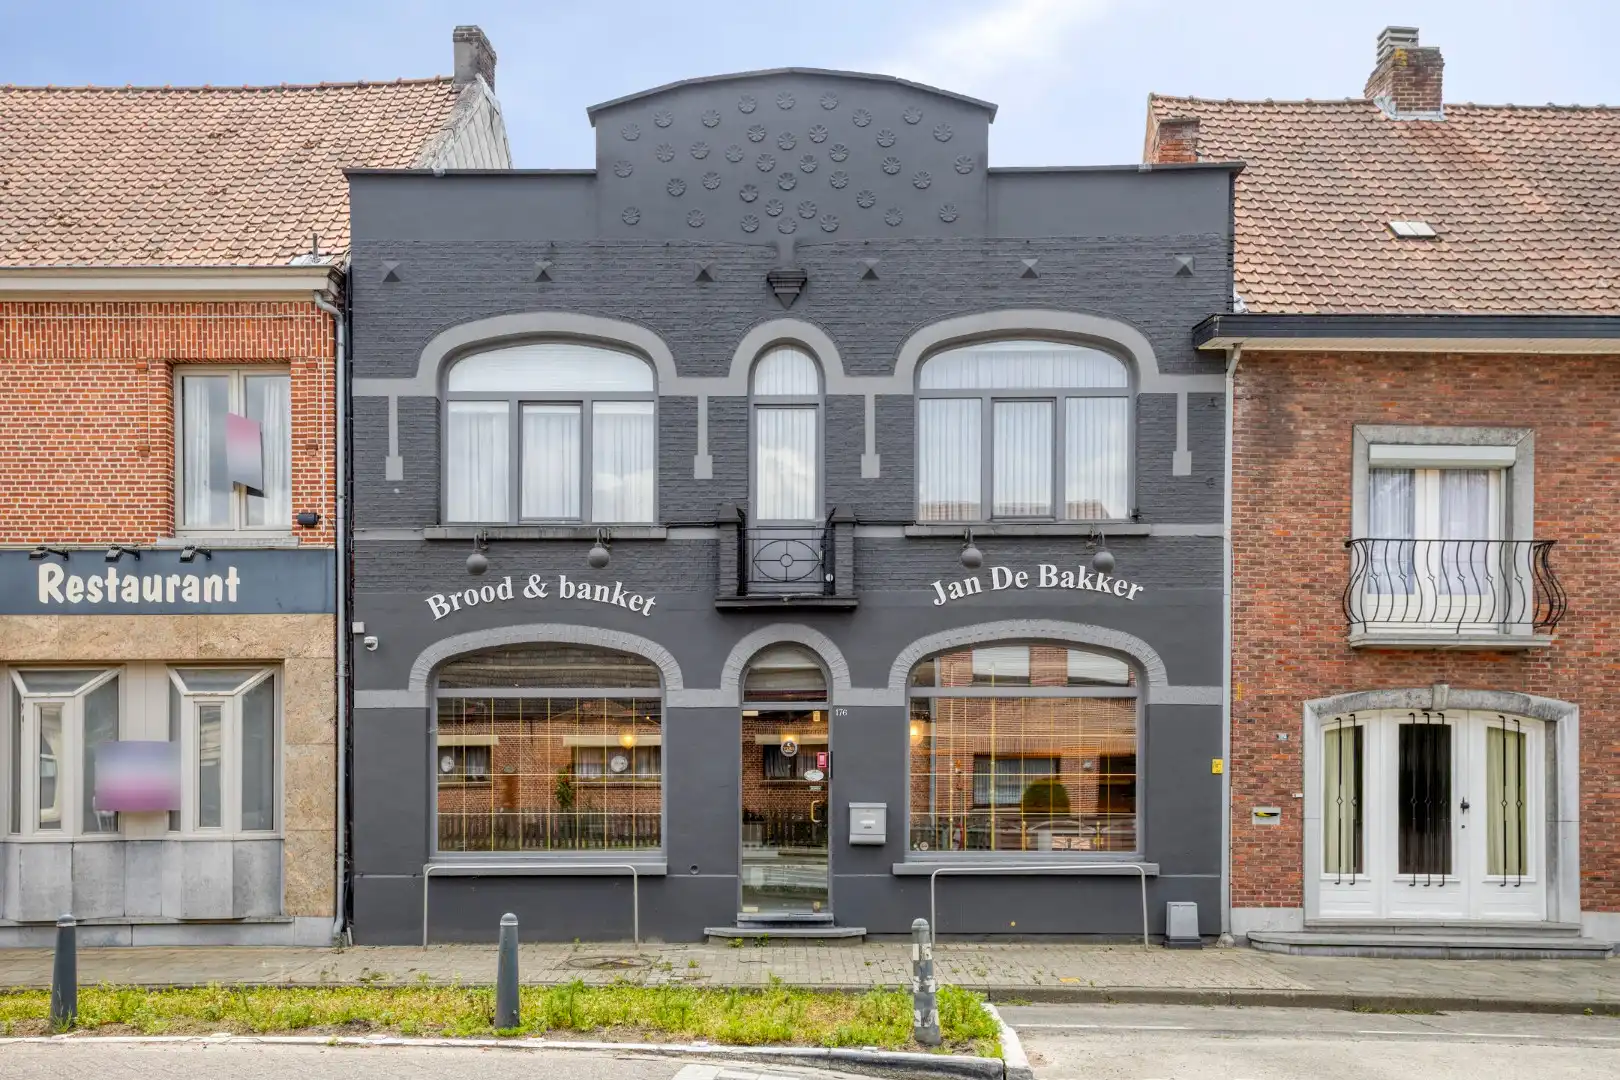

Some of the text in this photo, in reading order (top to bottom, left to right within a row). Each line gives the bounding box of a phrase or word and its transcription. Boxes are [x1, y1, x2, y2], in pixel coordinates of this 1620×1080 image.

[38, 562, 241, 604] Restaurant
[425, 574, 656, 621] Brood & banket
[930, 564, 1144, 606] Jan De Bakker
[835, 708, 848, 717] 176
